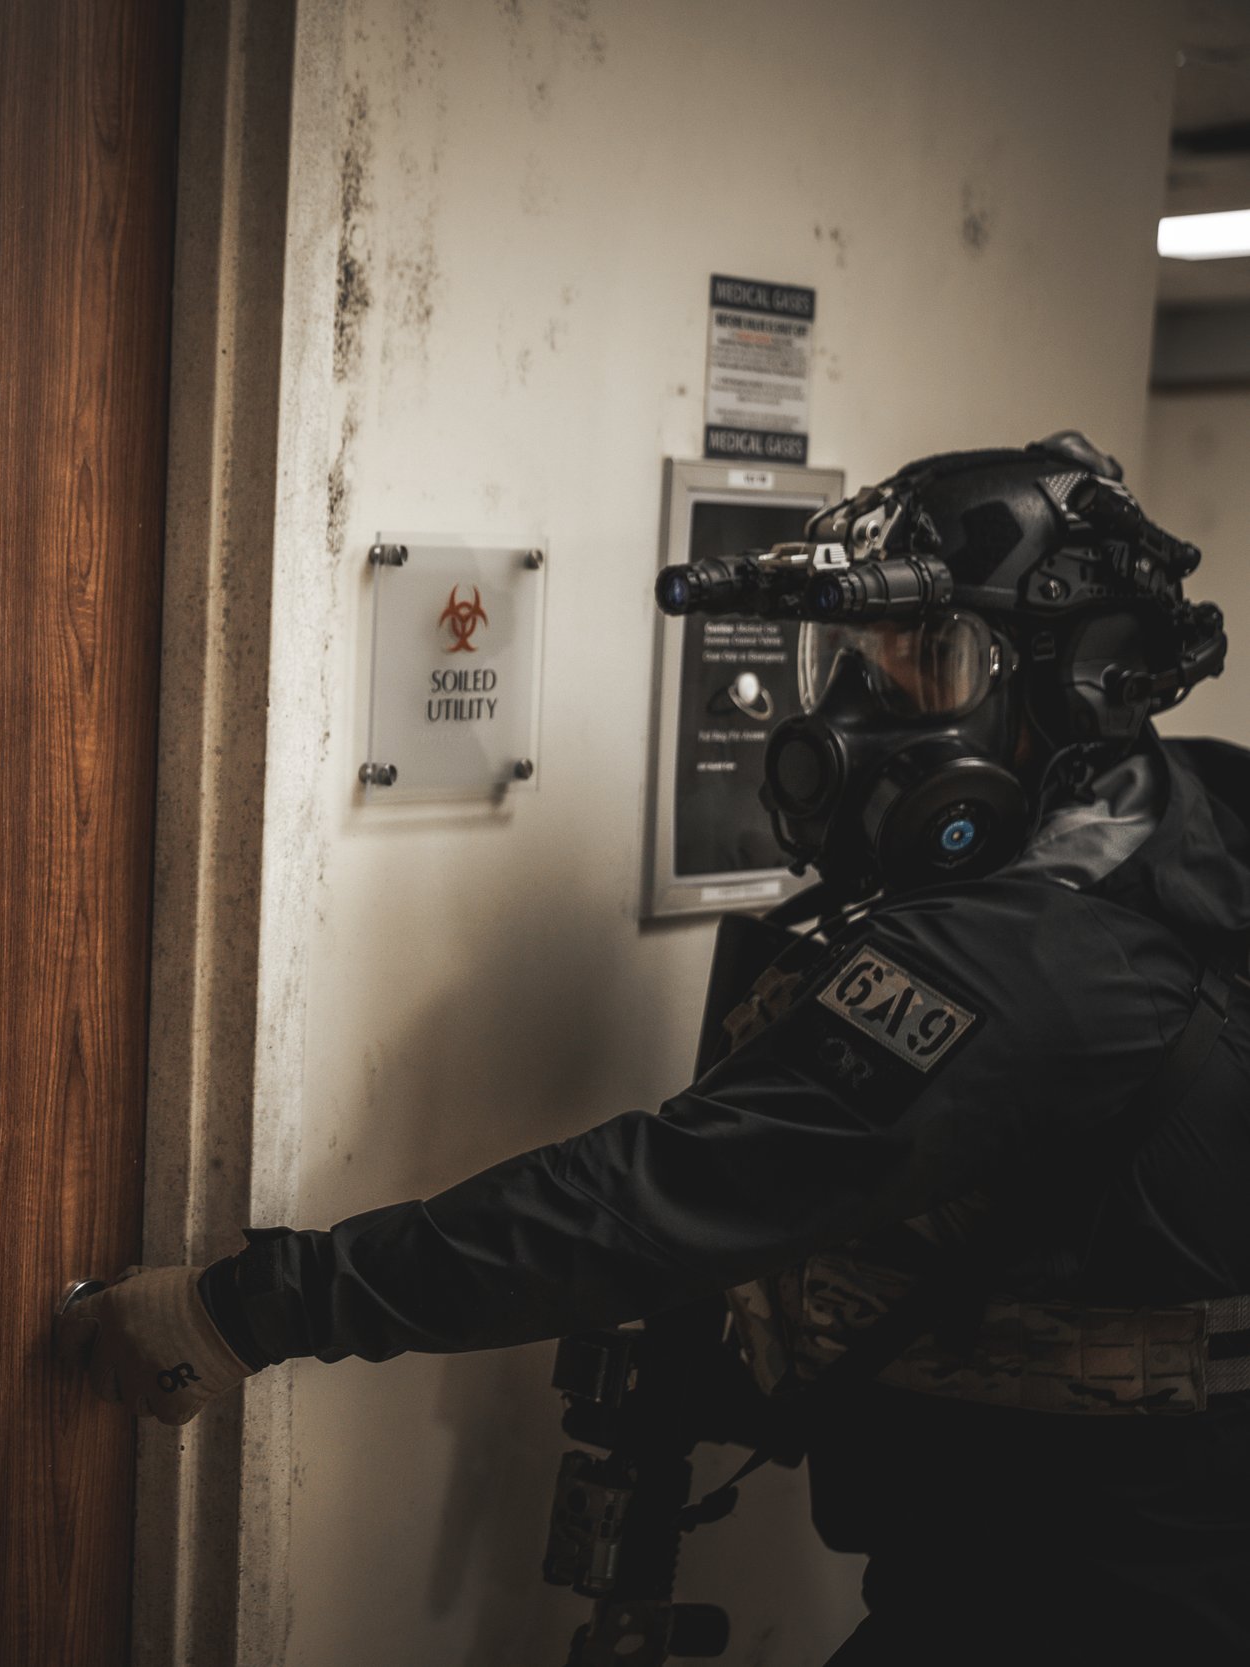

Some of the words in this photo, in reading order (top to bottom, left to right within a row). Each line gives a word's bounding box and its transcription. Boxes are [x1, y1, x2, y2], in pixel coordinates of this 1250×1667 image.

[714, 282, 770, 308] MEDICAL
[772, 290, 811, 313] GASES
[708, 430, 764, 455] MEDICAL
[765, 436, 804, 458] GASES
[430, 668, 498, 694] SOILED
[427, 697, 498, 722] UTILITY
[835, 960, 957, 1056] 6A9
[157, 1362, 202, 1393] OR
